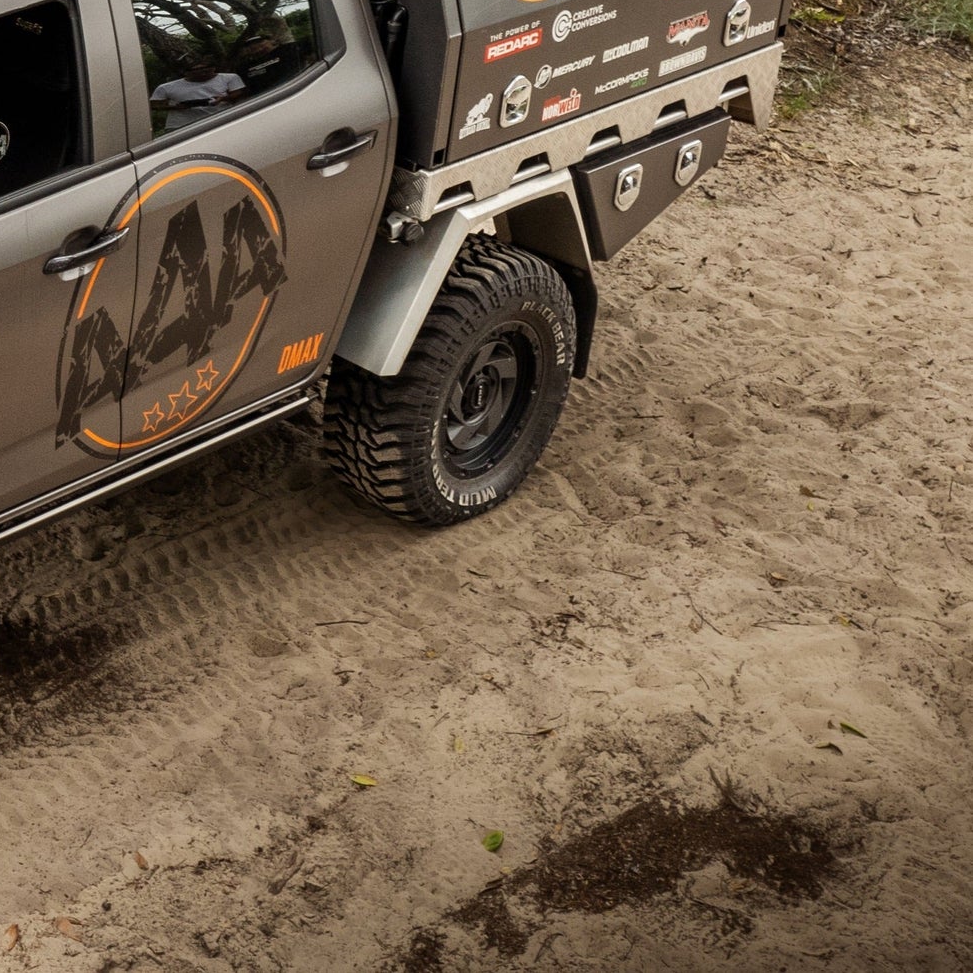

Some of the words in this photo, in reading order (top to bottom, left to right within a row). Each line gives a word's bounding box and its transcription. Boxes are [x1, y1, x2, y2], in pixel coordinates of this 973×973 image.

[571, 10, 618, 32] CONVERSIONS
[572, 4, 604, 22] CREATIVE
[490, 32, 503, 43] THE
[505, 23, 530, 38] POWER
[531, 20, 542, 29] OF
[487, 32, 539, 60] REDARC
[552, 55, 596, 78] MERCURY
[521, 301, 558, 324] BLACK
[551, 320, 567, 367] BEAR
[277, 333, 324, 374] DMAX
[458, 485, 497, 506] MUD
